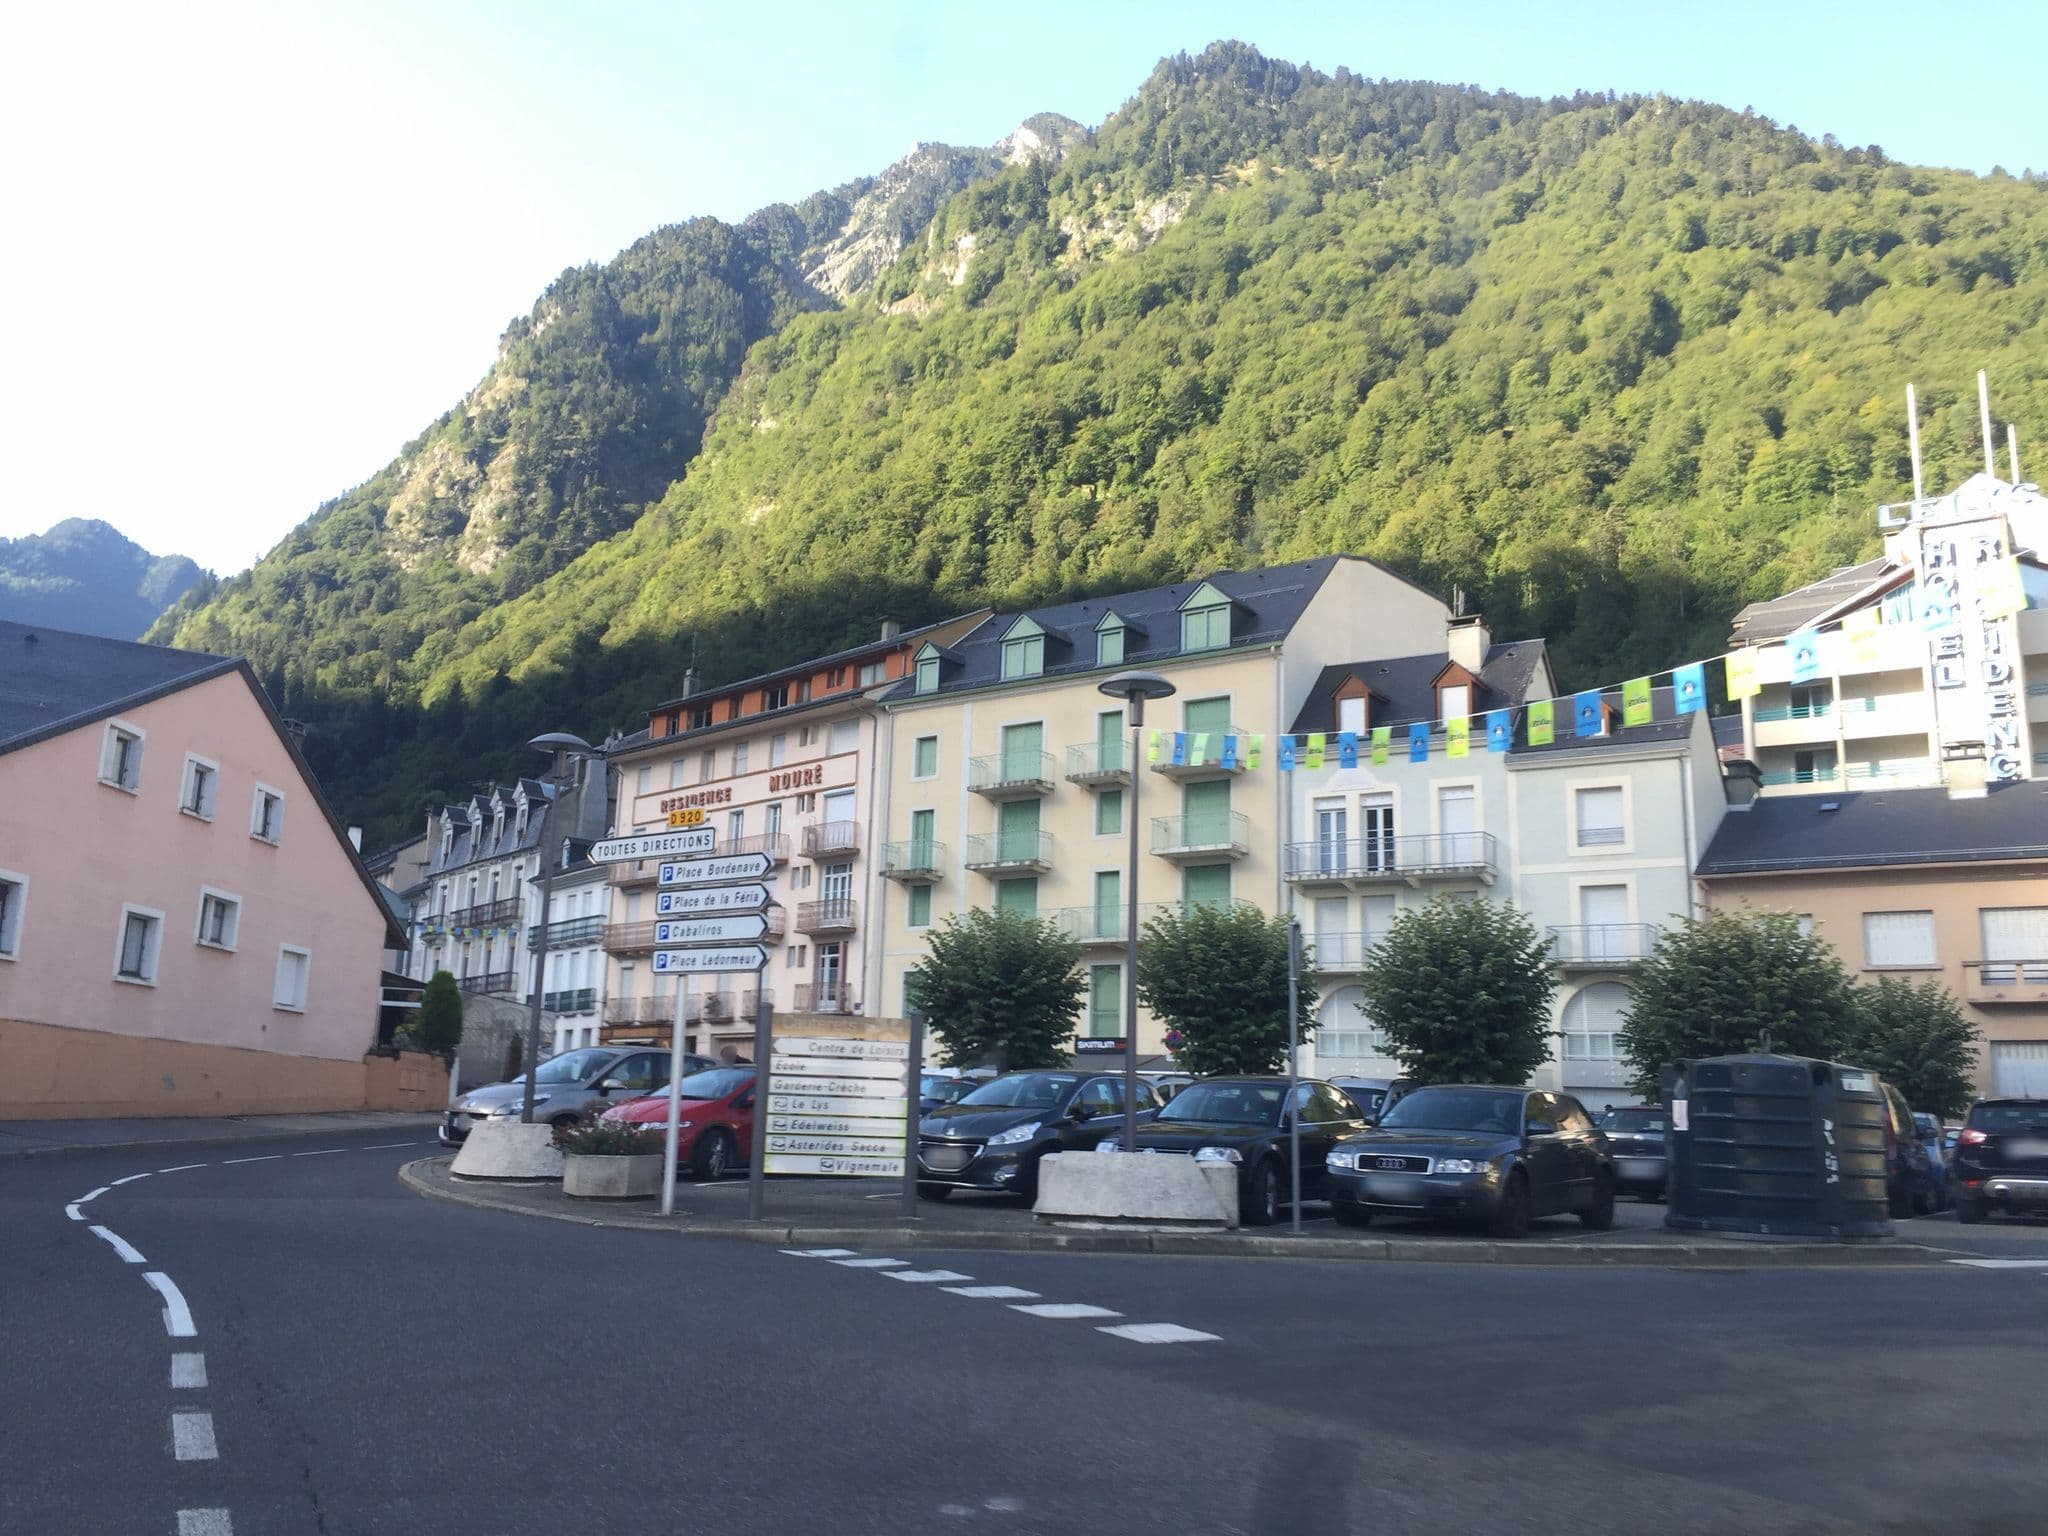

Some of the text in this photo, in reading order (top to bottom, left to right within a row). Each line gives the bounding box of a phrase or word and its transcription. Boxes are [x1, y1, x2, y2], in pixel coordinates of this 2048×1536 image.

[1923, 541, 1968, 691] HOEL
[661, 787, 732, 813] RESIDENCE
[670, 810, 701, 825] D 920
[598, 834, 711, 857] TOUTES DIRECTIONS
[676, 866, 702, 878] Place
[708, 861, 760, 876] Bordenave
[674, 895, 699, 907] Place
[704, 894, 716, 906] de
[720, 892, 730, 904] la
[672, 924, 722, 938] Cabaliros
[670, 954, 696, 967] Place
[702, 953, 756, 966] Ledormeur
[808, 1042, 846, 1054] Centre
[850, 1044, 864, 1055] de
[792, 1099, 829, 1112] Le Lys
[790, 1119, 850, 1132] Edelweiss
[835, 1159, 900, 1174] Vignemale
